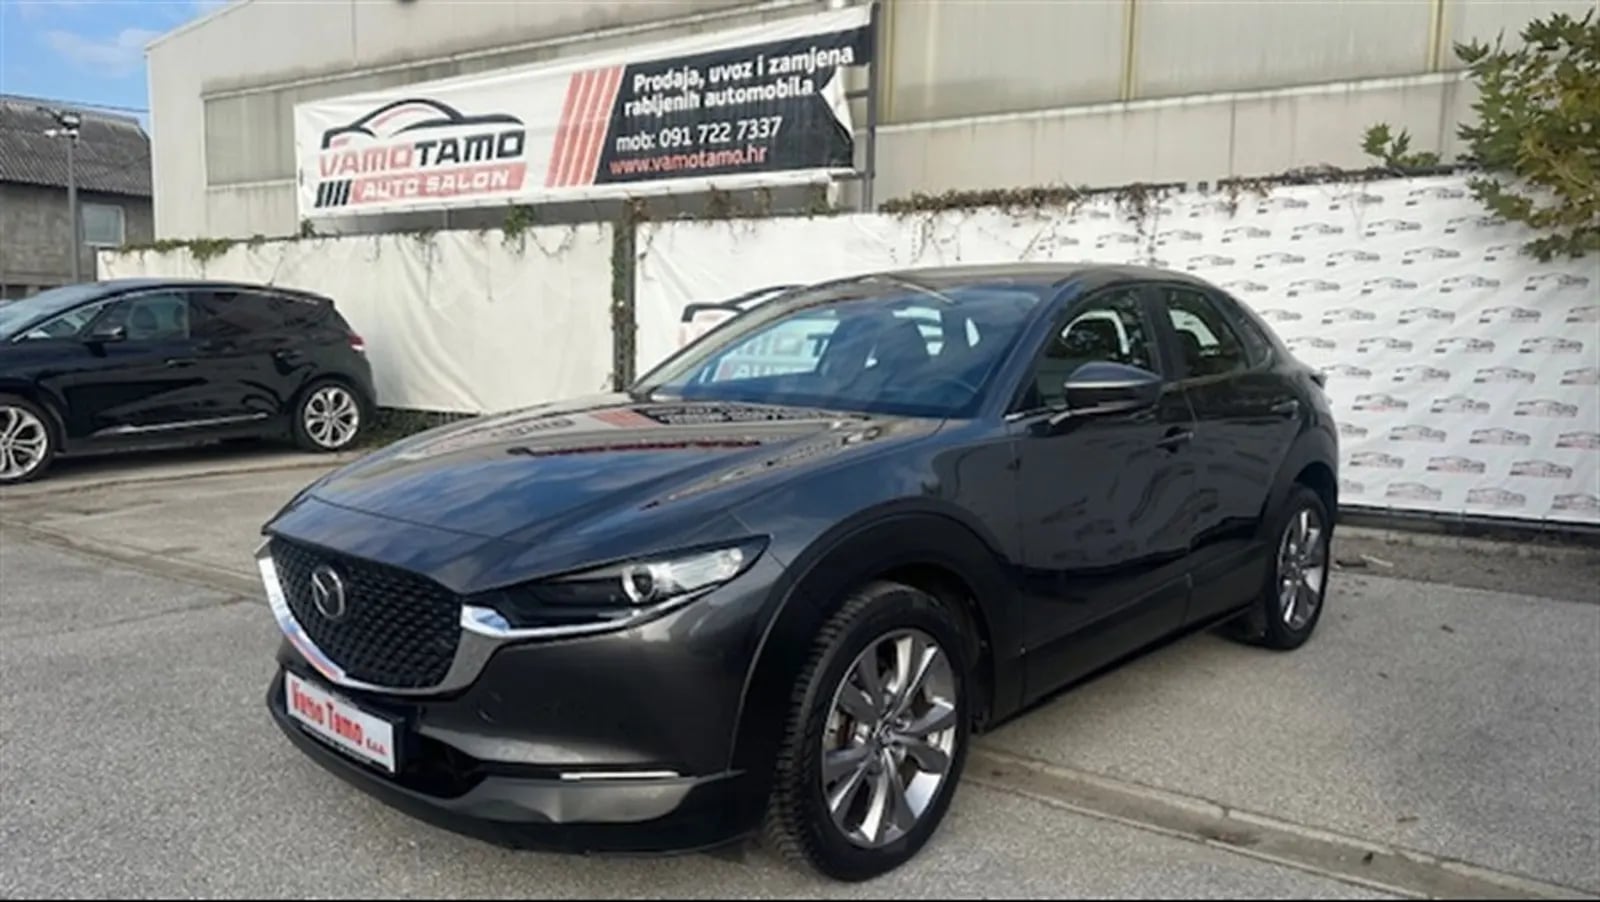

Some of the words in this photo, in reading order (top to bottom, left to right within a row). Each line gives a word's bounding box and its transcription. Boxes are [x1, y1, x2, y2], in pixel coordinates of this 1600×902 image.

[633, 66, 704, 92] Prodaja,
[709, 64, 753, 83] uvoz
[757, 55, 764, 76] i
[768, 46, 854, 74] zamjena
[624, 91, 701, 117] rabljenih
[704, 76, 814, 107] automobila
[319, 129, 526, 177] VAMOTAMO
[616, 131, 655, 152] mob:
[659, 126, 692, 148] 091
[697, 122, 731, 143] 722
[738, 116, 782, 140] 7337
[609, 144, 767, 175] www.vamotamo.hr
[361, 180, 418, 199] AUTO
[425, 169, 510, 193] SALON
